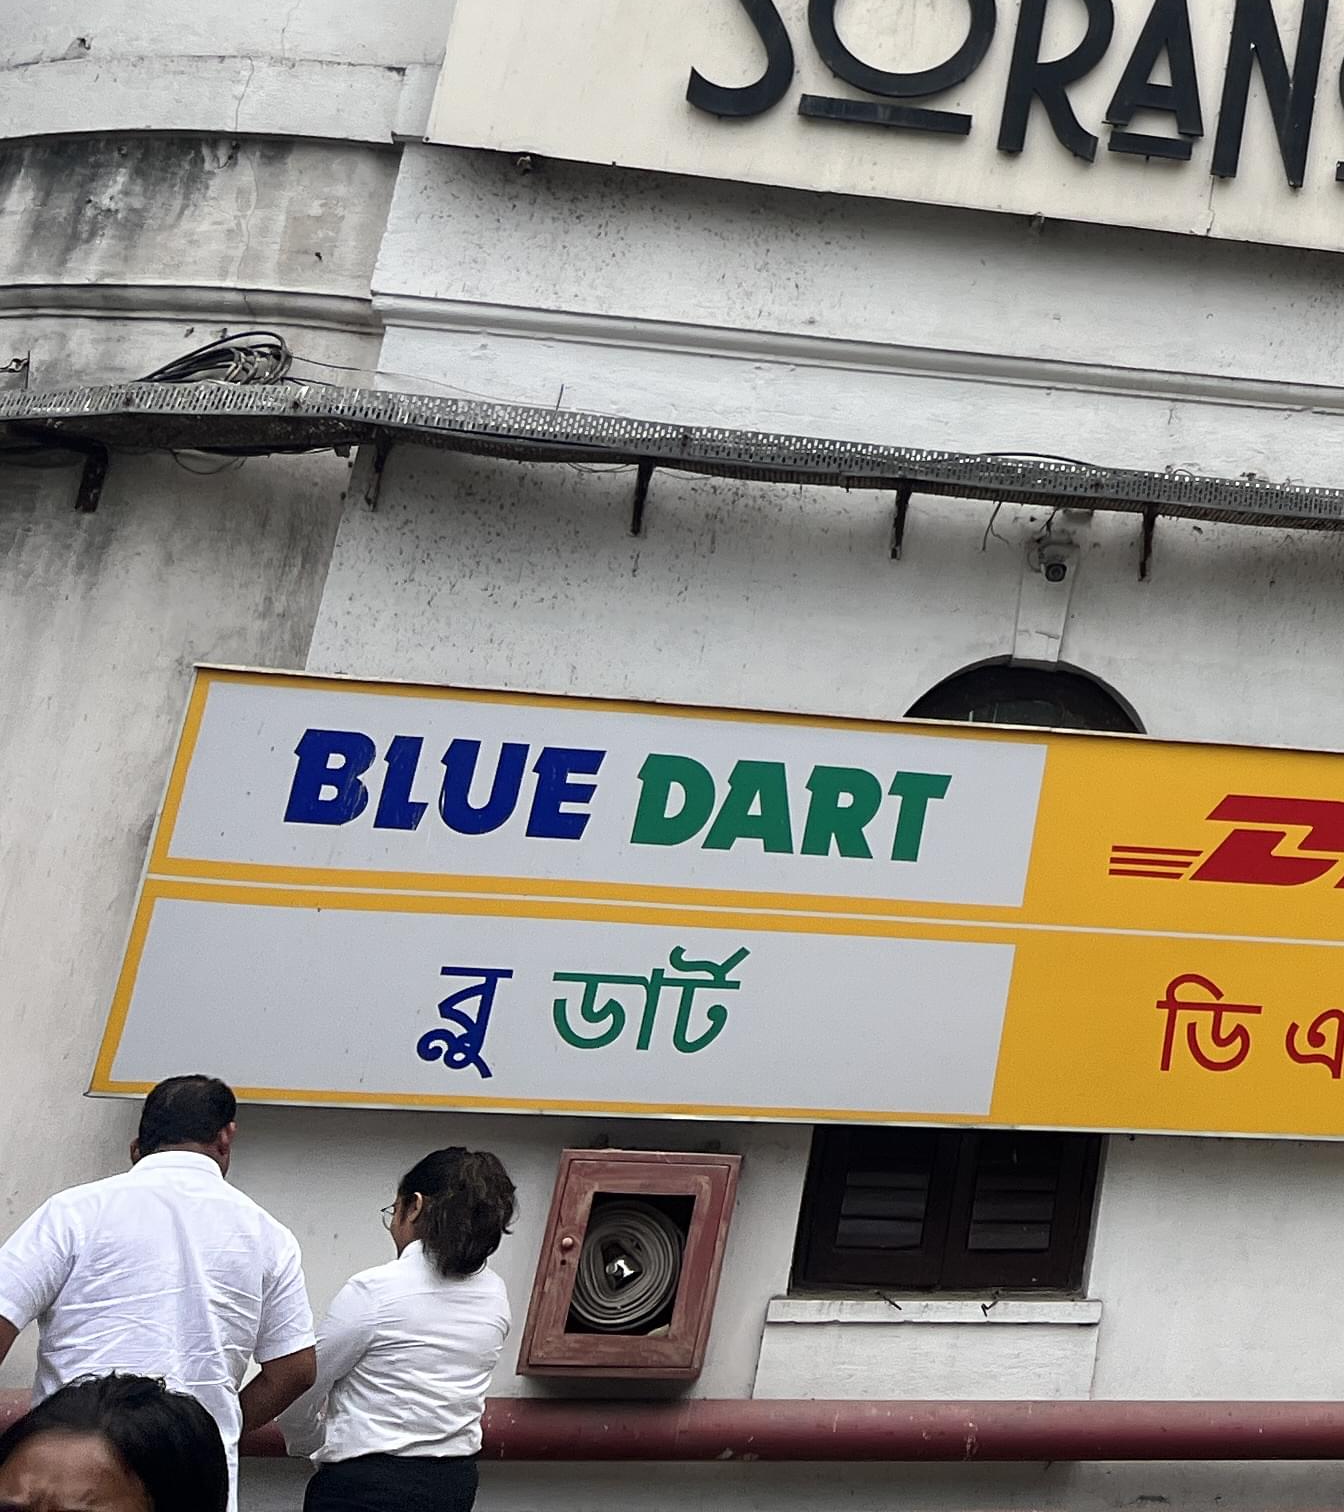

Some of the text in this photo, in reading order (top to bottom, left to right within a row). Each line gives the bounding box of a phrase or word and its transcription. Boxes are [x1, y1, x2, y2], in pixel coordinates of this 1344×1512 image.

[283, 728, 953, 863] BLUE DART
[551, 945, 751, 1056] ডার্ট
[1156, 972, 1263, 1072] ডি
